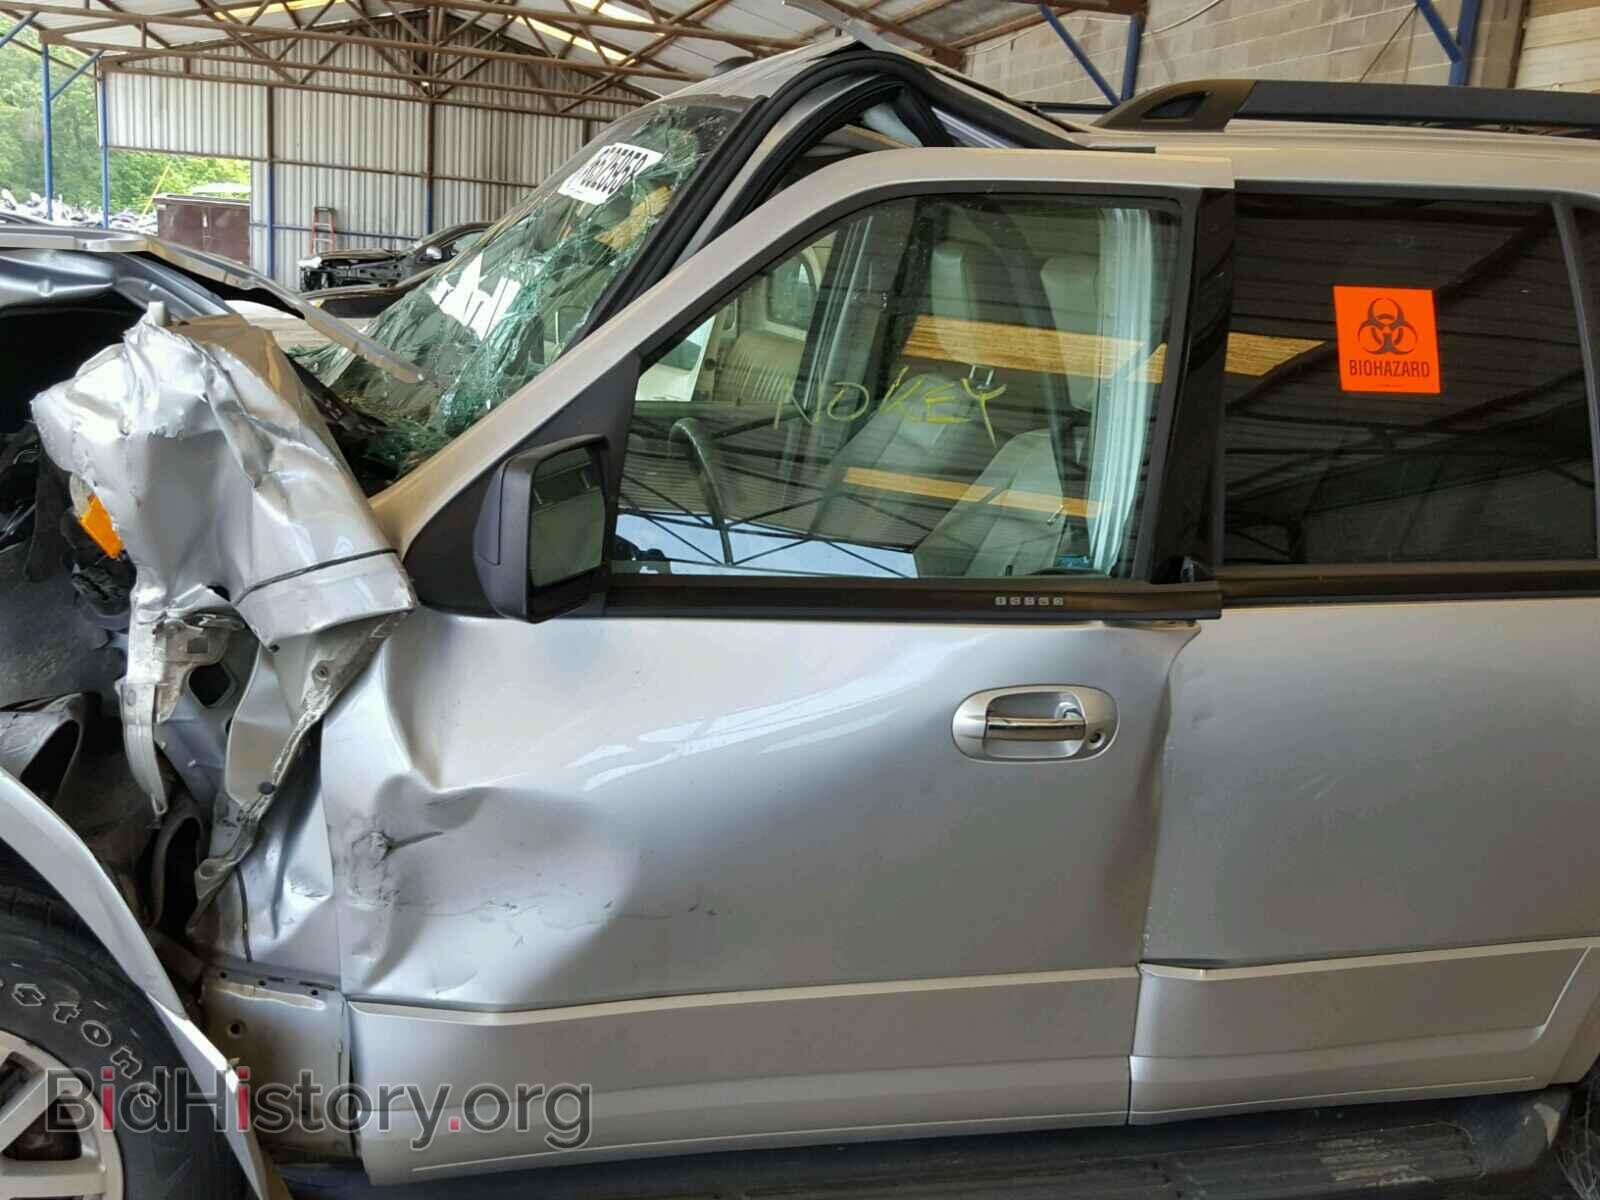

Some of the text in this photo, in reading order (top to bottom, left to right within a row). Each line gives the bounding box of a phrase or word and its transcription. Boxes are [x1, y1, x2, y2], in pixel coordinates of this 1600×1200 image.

[879, 364, 1007, 449] KEY
[1349, 359, 1431, 378] BIOHAZARD
[0, 976, 163, 1108] stone
